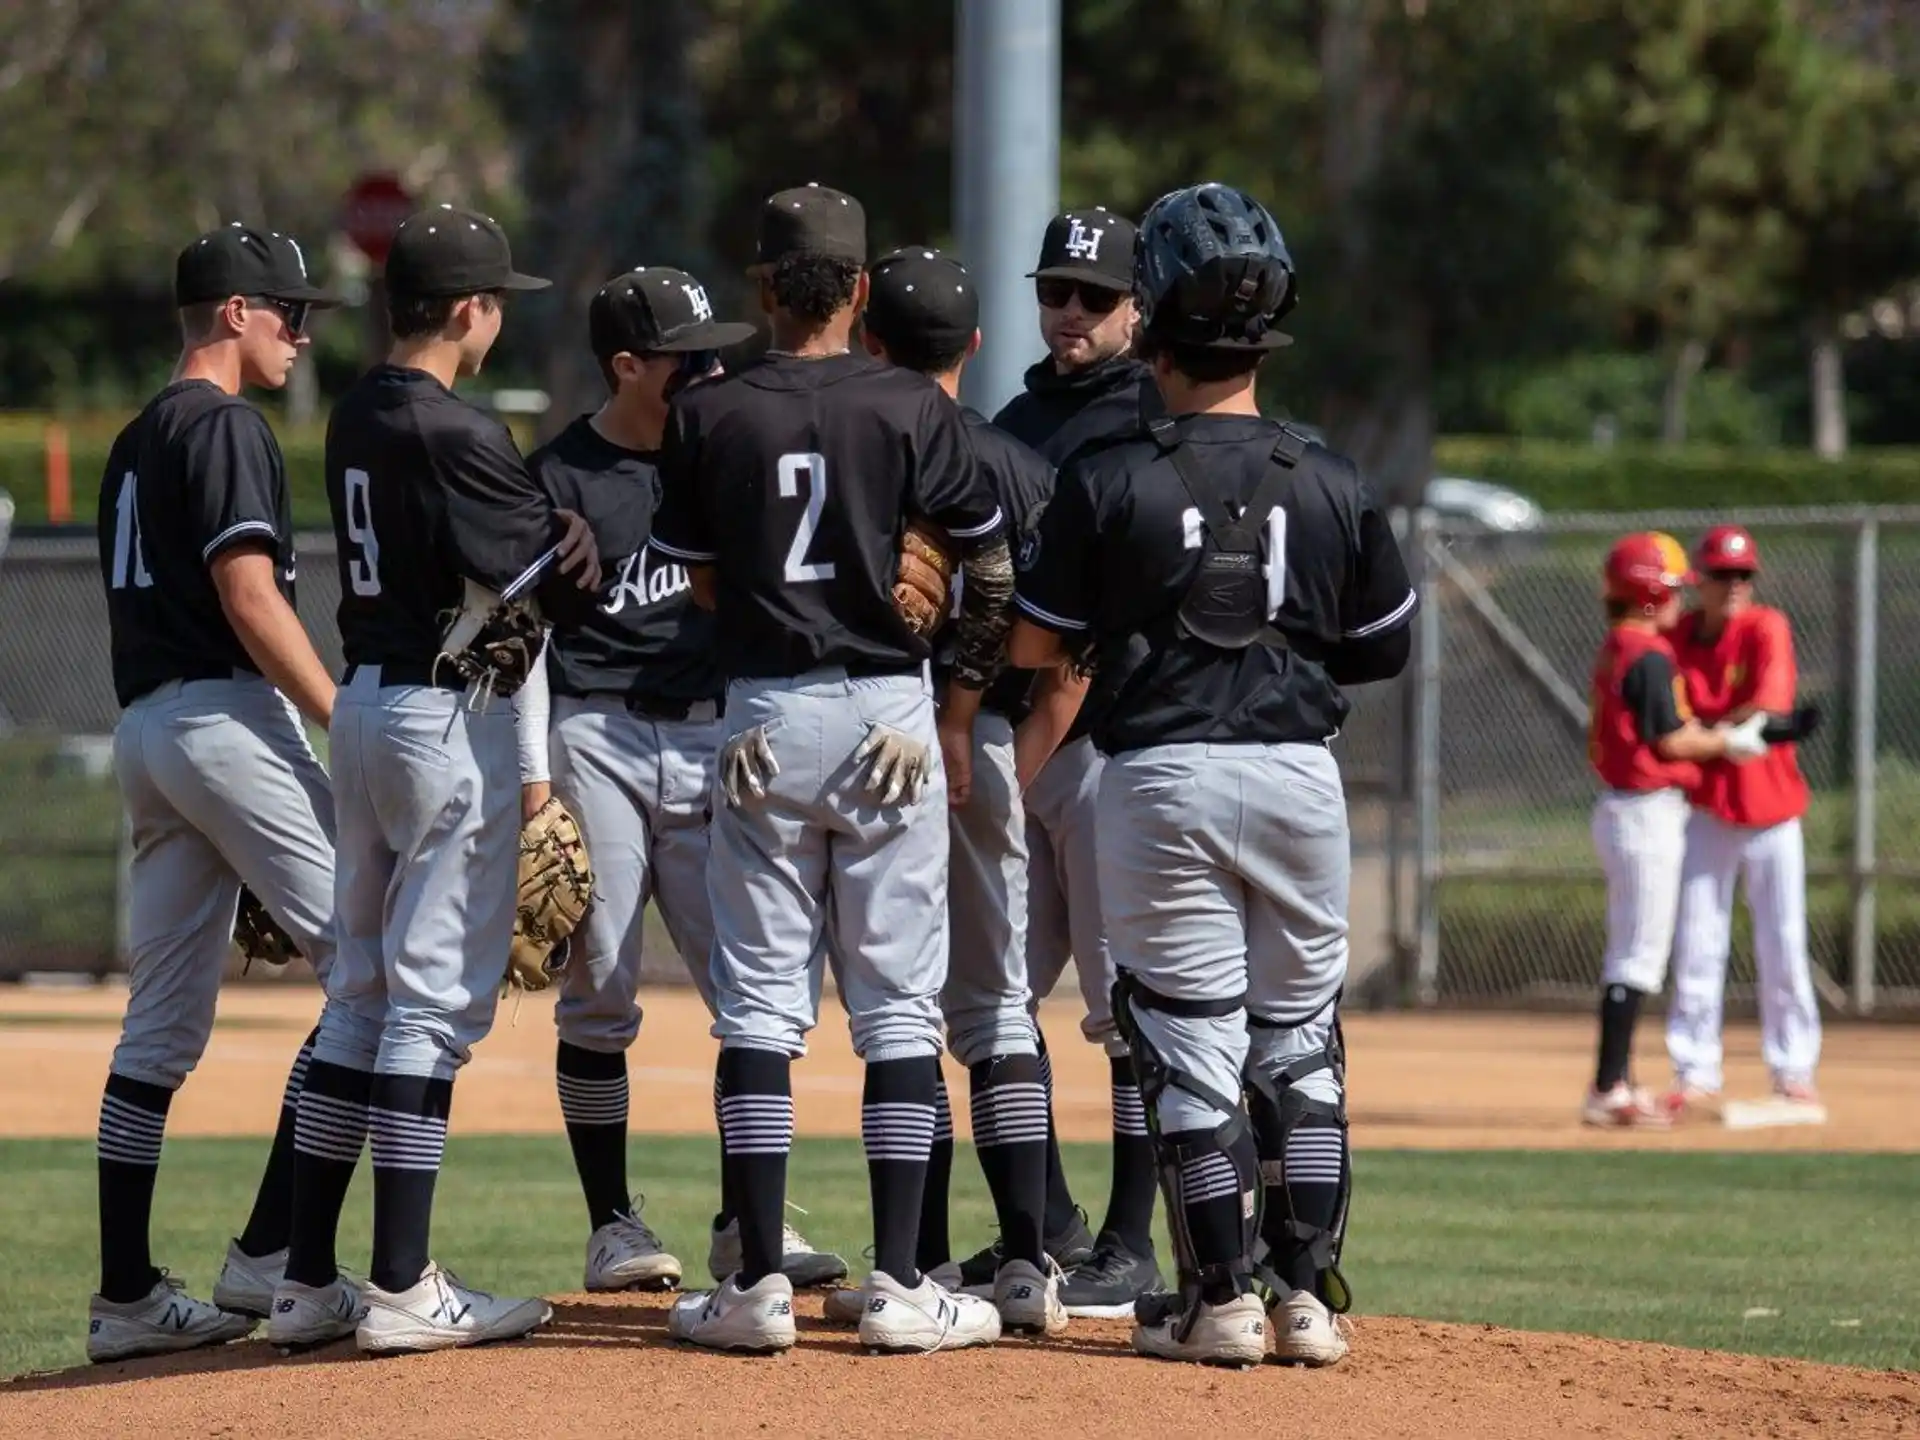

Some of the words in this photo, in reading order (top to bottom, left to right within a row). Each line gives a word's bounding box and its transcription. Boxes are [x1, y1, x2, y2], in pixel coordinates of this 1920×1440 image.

[1065, 219, 1103, 260] LH
[112, 468, 154, 588] 1
[345, 467, 381, 596] 9
[778, 453, 835, 582] 2
